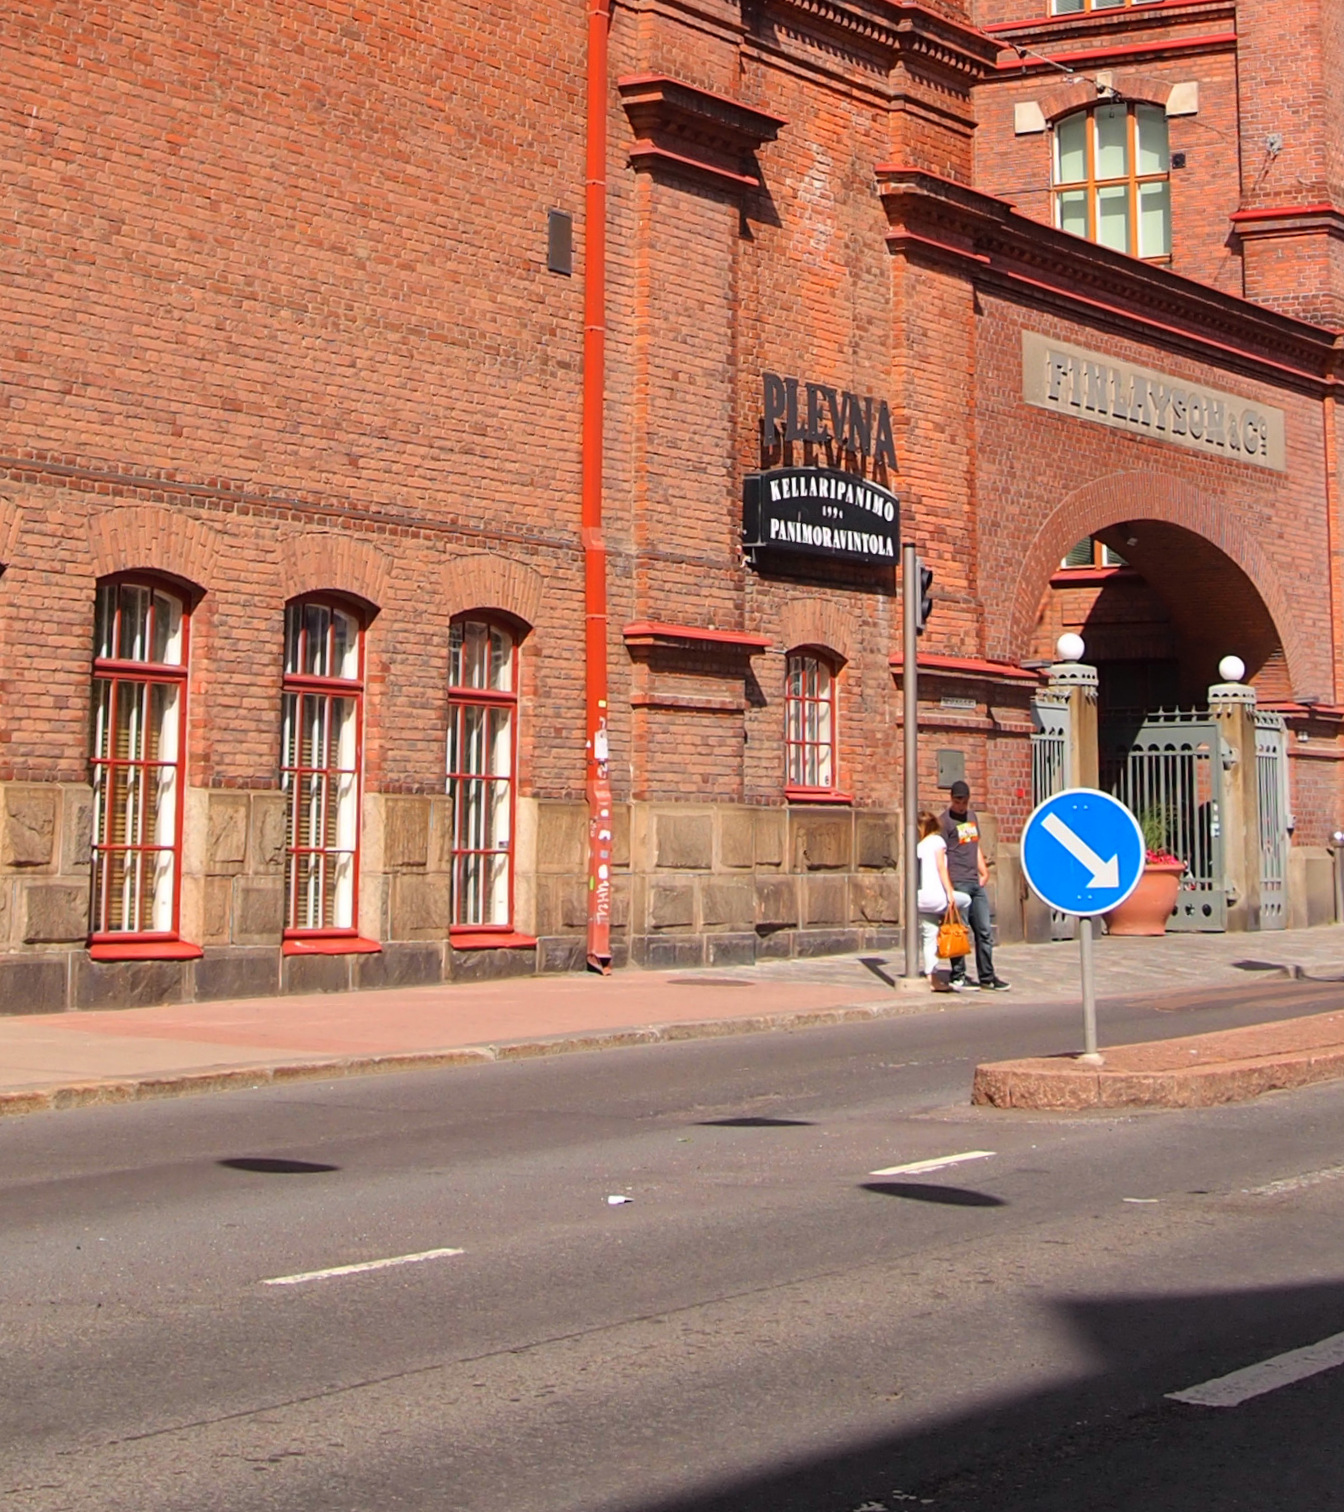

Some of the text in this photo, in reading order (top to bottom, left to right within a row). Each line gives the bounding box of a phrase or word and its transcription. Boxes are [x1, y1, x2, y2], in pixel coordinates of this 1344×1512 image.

[762, 372, 899, 473] PLEVNA
[1045, 348, 1226, 448] FINLAYSON
[769, 476, 895, 523] KELLARIPANIMO
[769, 518, 894, 558] PANIMORAVINTOLA
